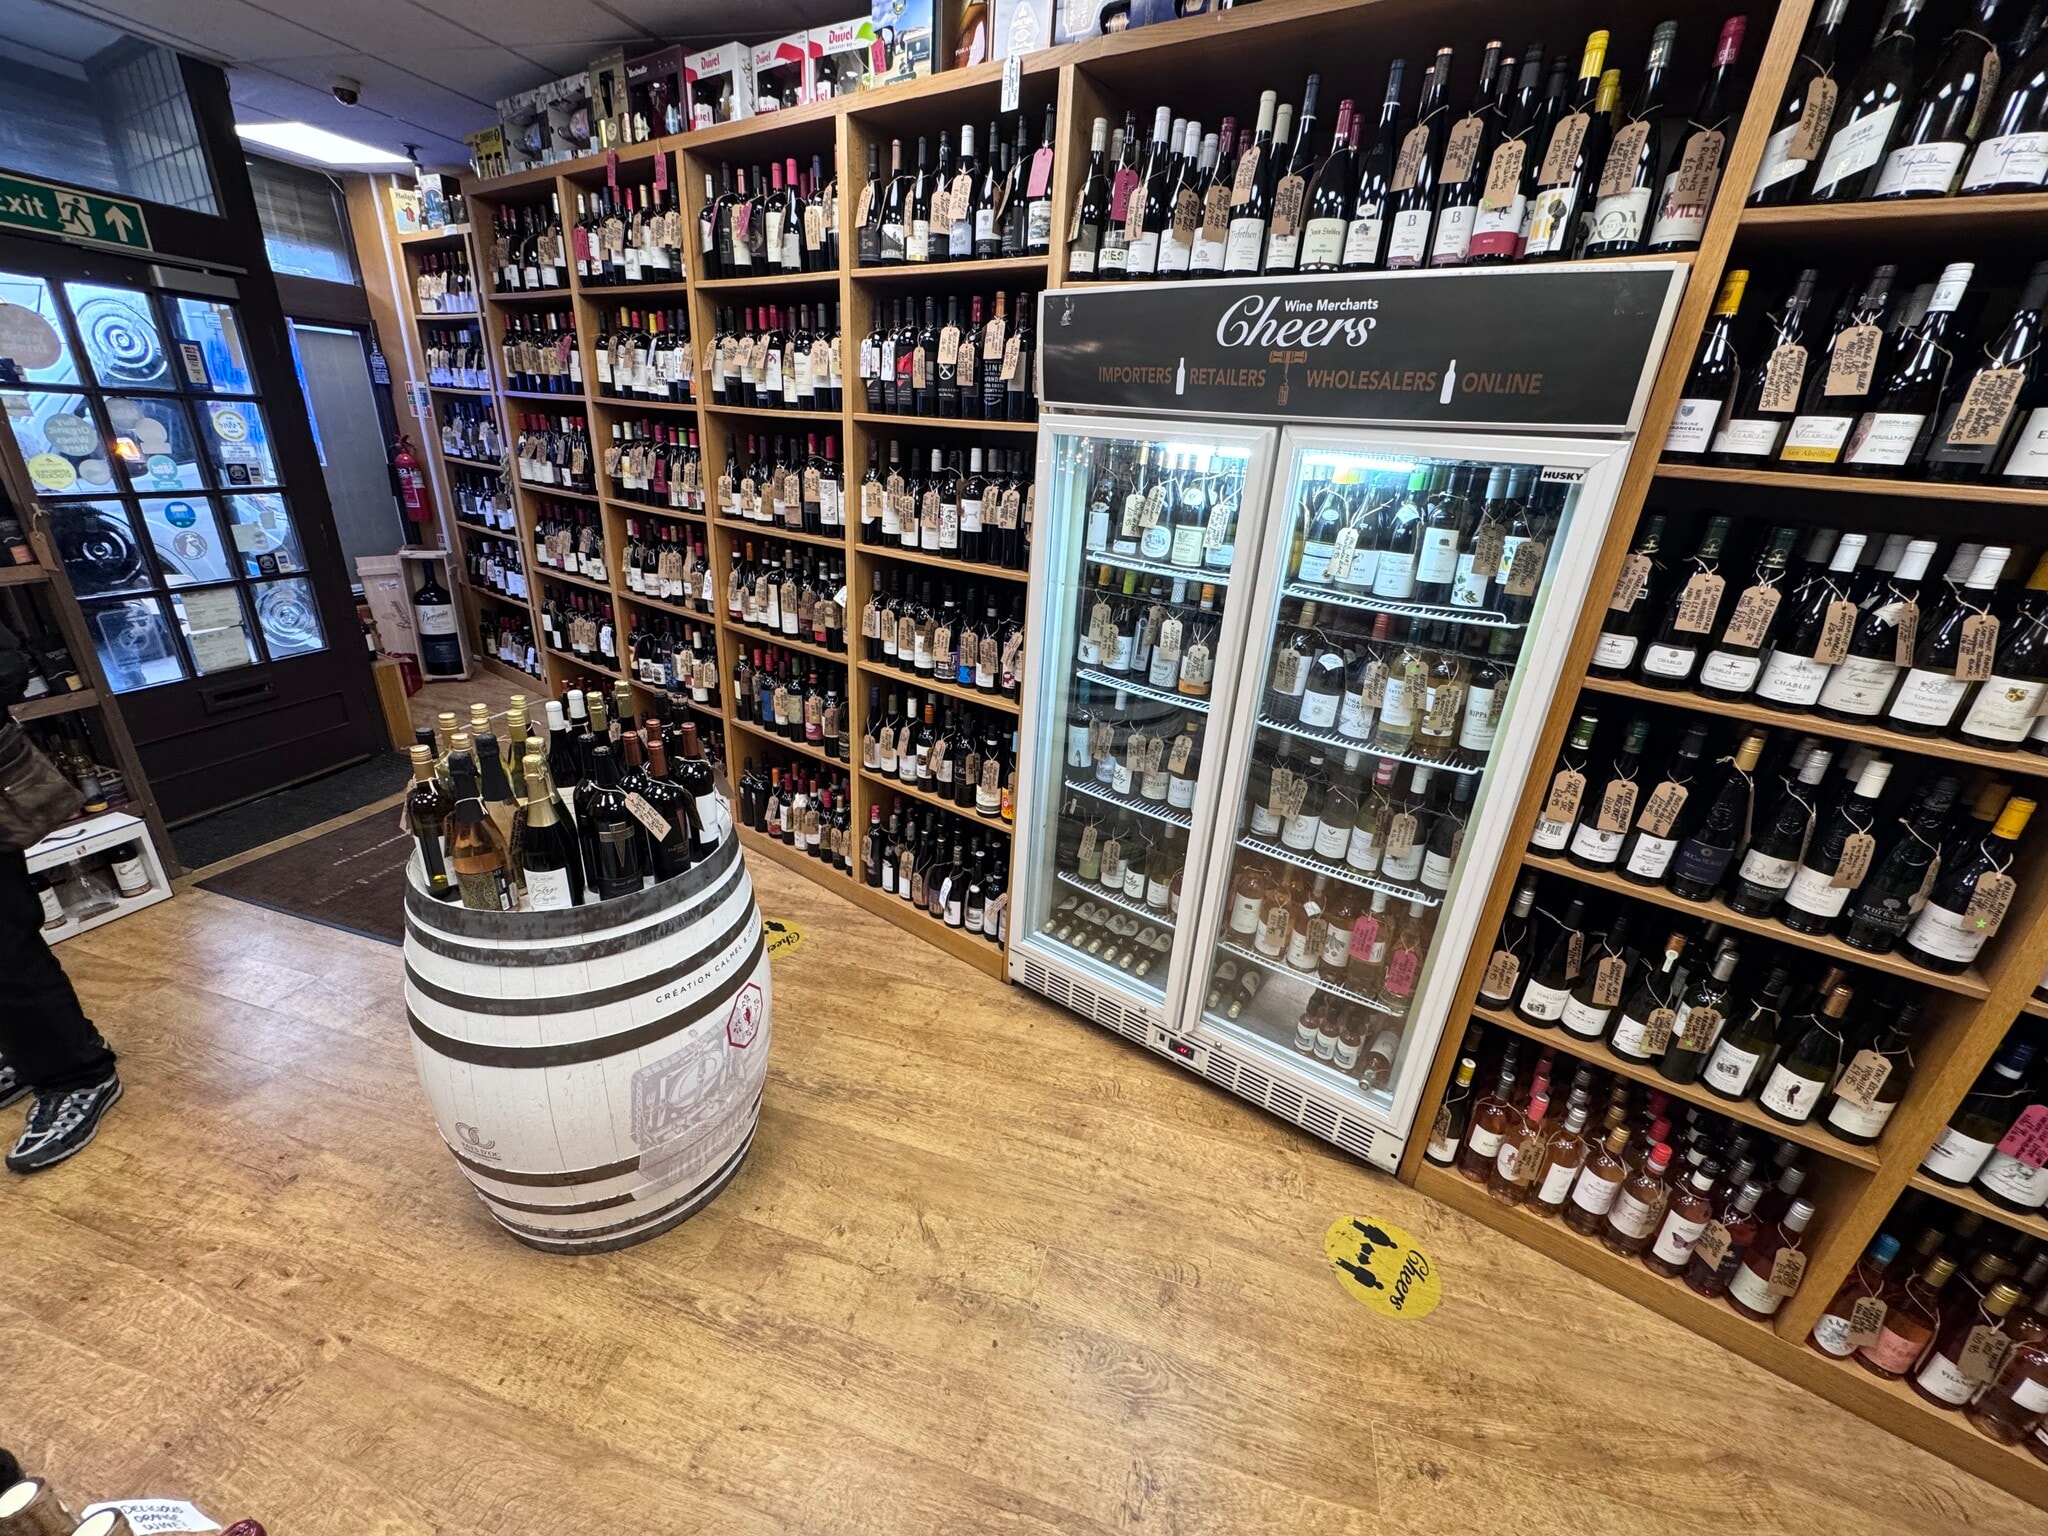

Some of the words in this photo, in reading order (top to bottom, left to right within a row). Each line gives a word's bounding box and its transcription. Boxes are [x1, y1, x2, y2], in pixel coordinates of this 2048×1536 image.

[828, 27, 853, 44] Duvel
[701, 53, 720, 70] Duvel
[756, 51, 771, 65] Duvel
[1705, 138, 1721, 171] FRITZ
[1284, 299, 1312, 312] Wine
[1316, 297, 1379, 312] Merchants
[1216, 294, 1377, 348] Cheers
[1099, 365, 1172, 384] IMPORTERS
[1189, 367, 1266, 388] RETAILERS
[1306, 369, 1437, 392] WHOLESALERS
[1461, 372, 1543, 395] ONLINE
[1543, 470, 1583, 482] HUSKY
[1657, 657, 1683, 666] CHABLIS
[1773, 678, 1811, 690] CHABLIS
[655, 971, 711, 1004] CRÉATION
[713, 942, 745, 972] CALMEL
[1844, 1063, 1863, 1085] £9.95
[1390, 1250, 1429, 1311] Cheers
[120, 1504, 184, 1515] DELICIOUS
[134, 1513, 181, 1524] ORANGE
